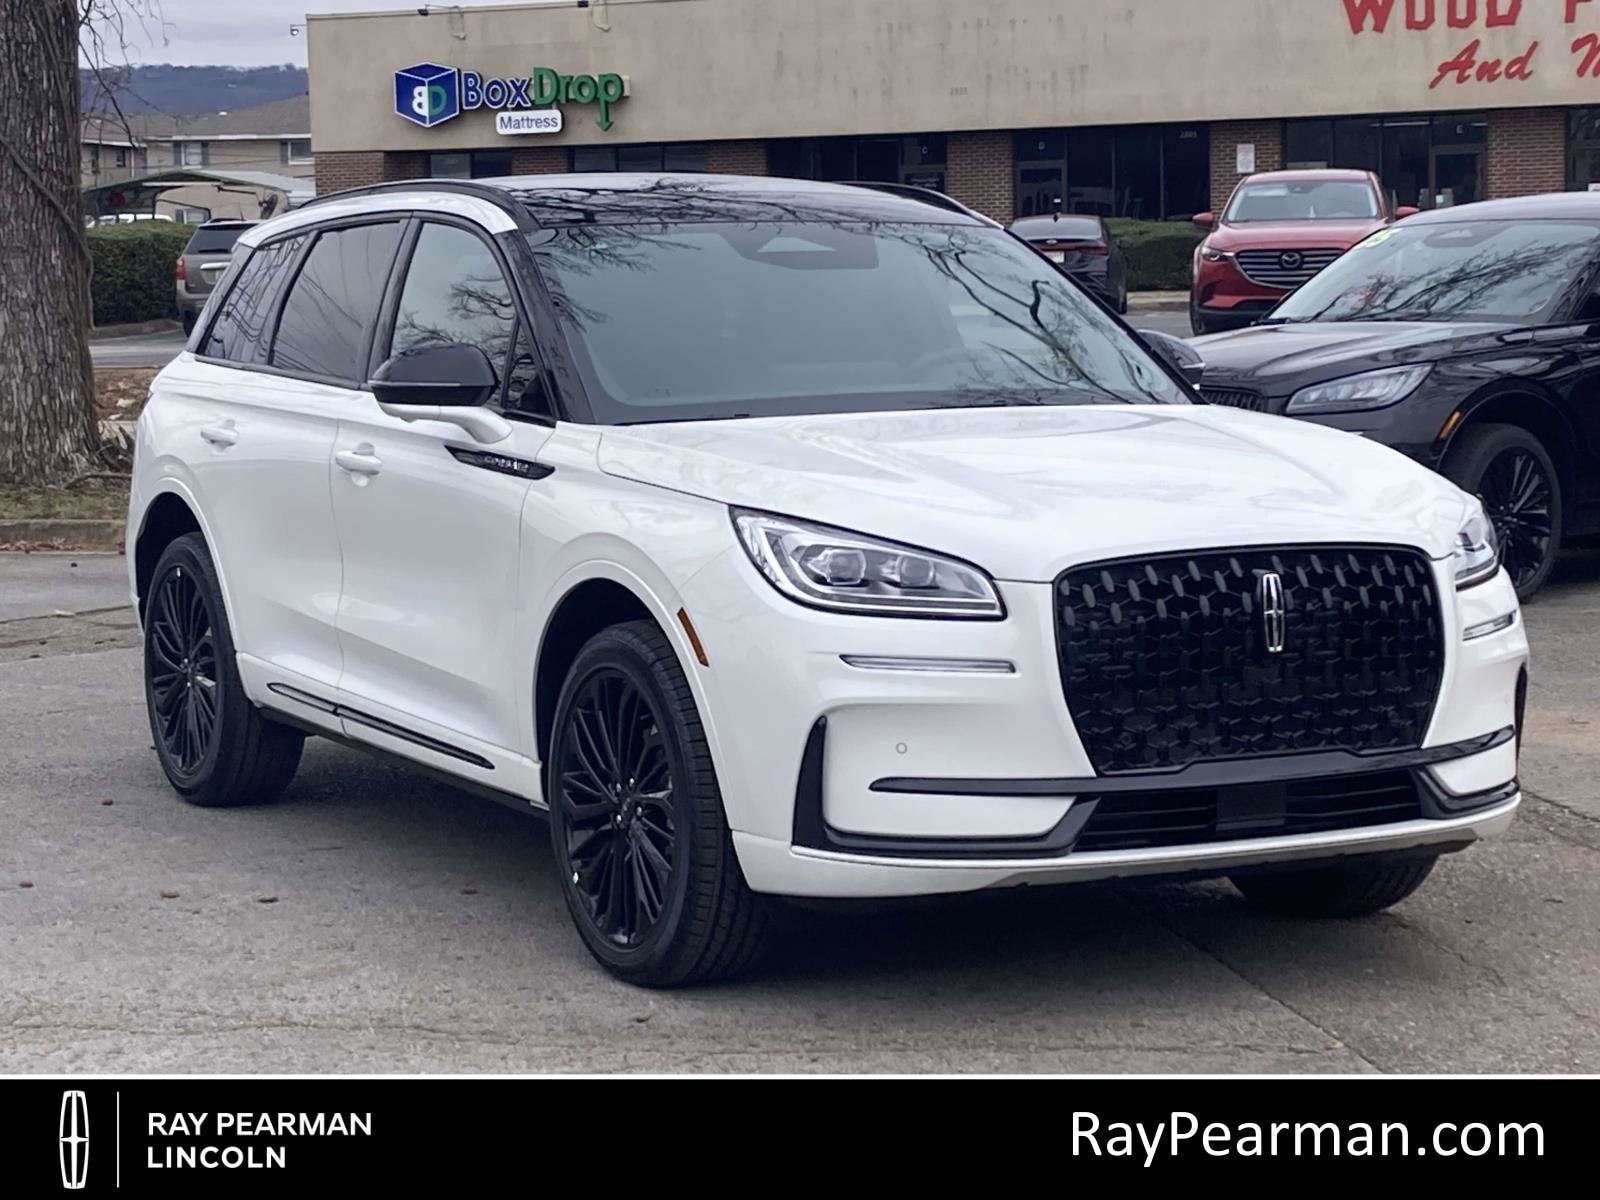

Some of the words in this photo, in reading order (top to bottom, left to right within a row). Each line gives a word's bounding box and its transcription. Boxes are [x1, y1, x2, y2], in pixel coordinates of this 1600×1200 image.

[1429, 38, 1539, 90] And
[462, 67, 624, 132] BoxDrop
[500, 115, 559, 130] Mattress
